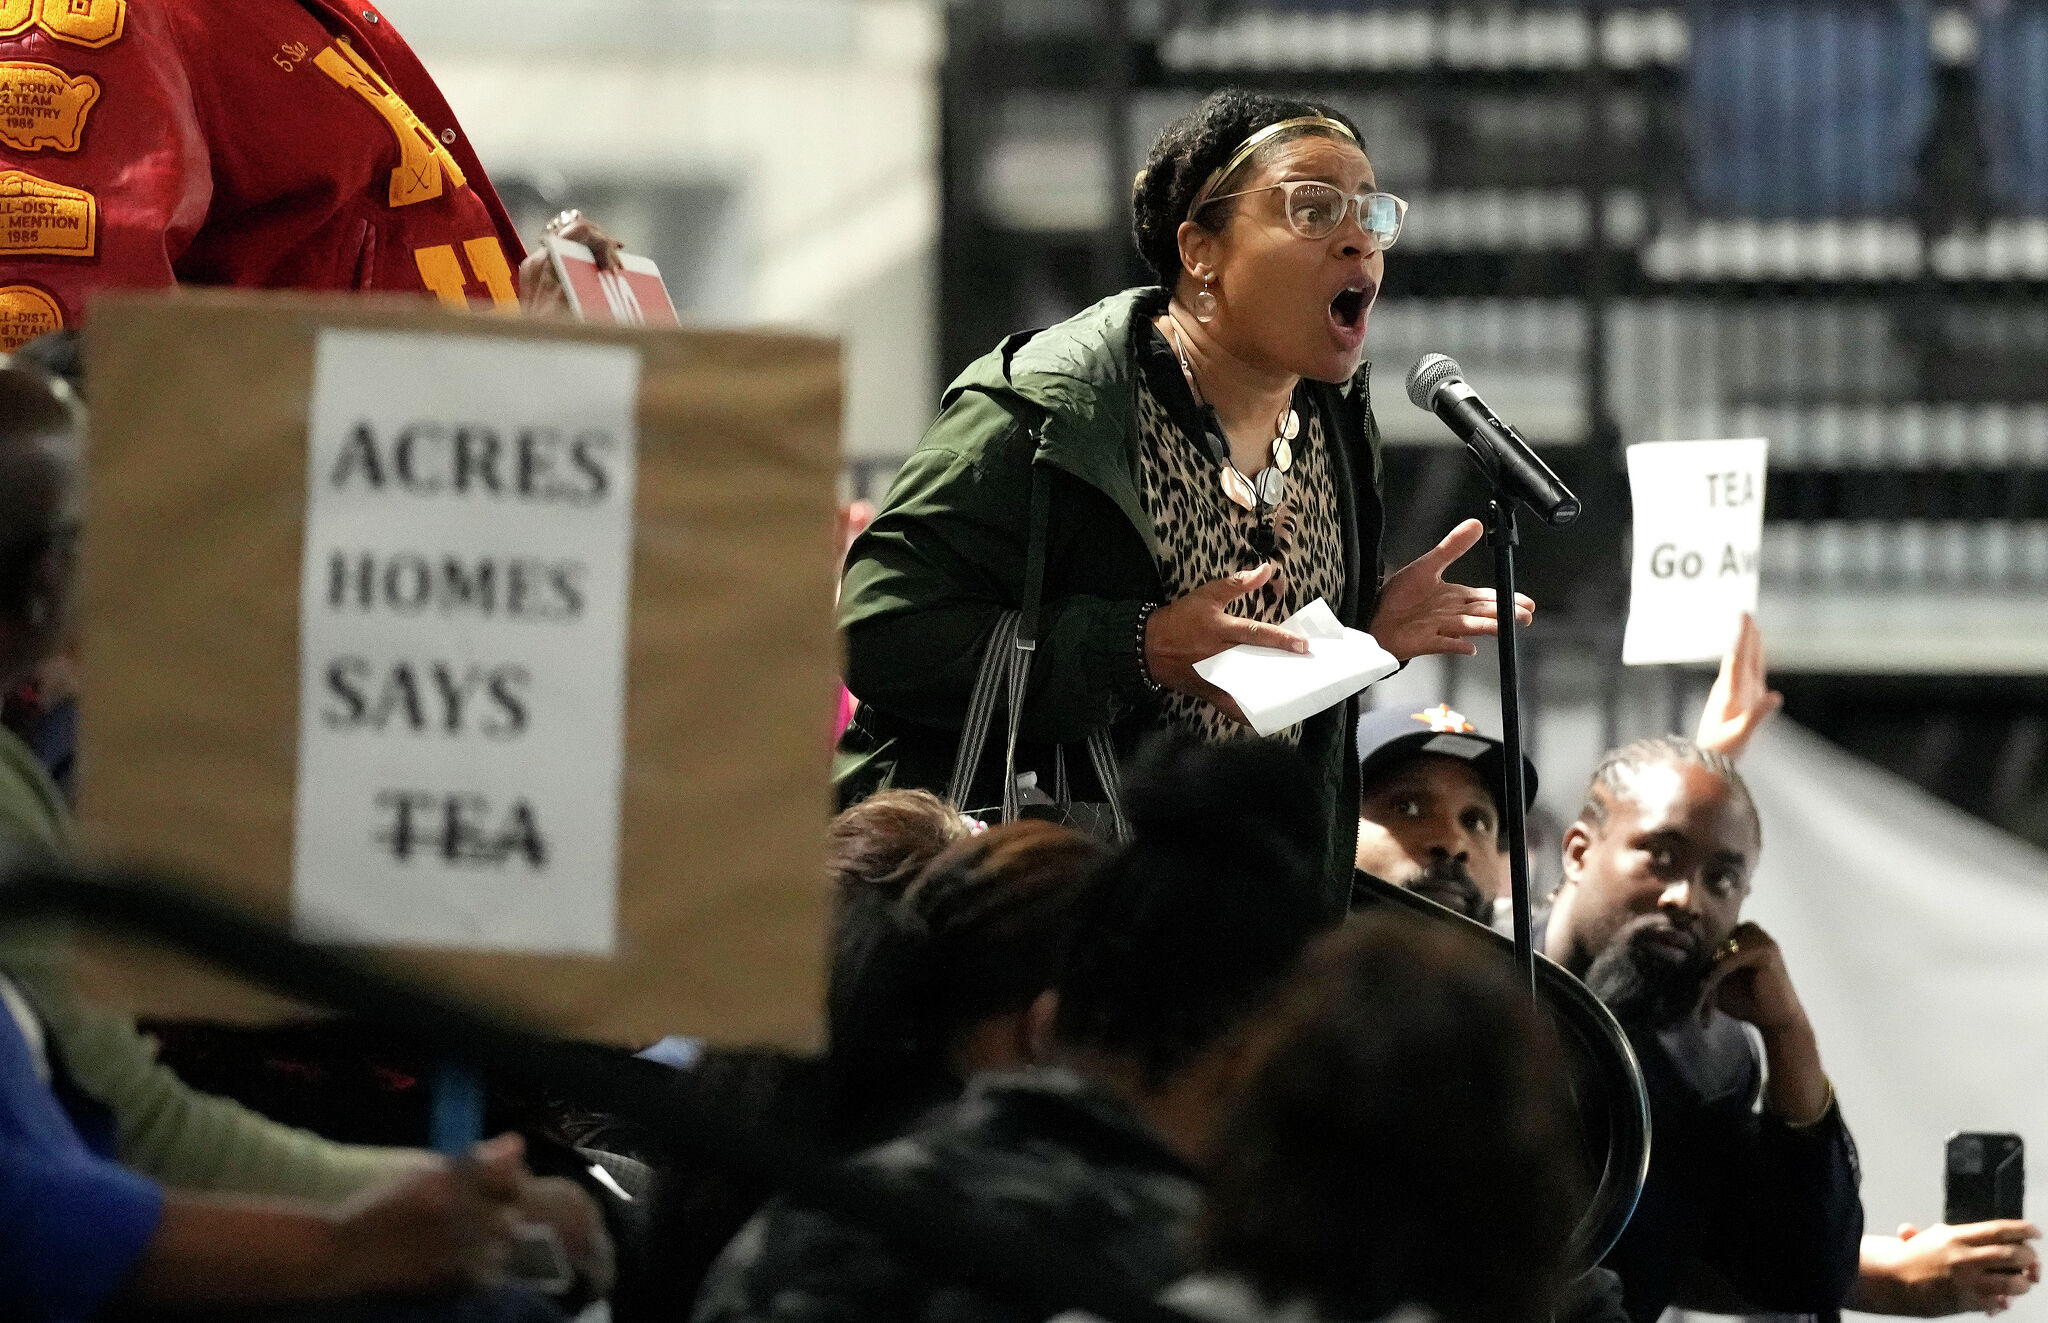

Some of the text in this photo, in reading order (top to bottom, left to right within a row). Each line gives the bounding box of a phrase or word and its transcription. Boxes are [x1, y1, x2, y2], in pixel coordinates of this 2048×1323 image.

[13, 93, 52, 106] TEAM
[18, 82, 65, 96] TODAY
[8, 215, 79, 230] MENTION
[329, 417, 616, 507] ACRES
[326, 547, 590, 625] HOMES
[1649, 542, 1704, 579] Go
[319, 654, 534, 740] SAYS
[370, 786, 550, 873] TEA
